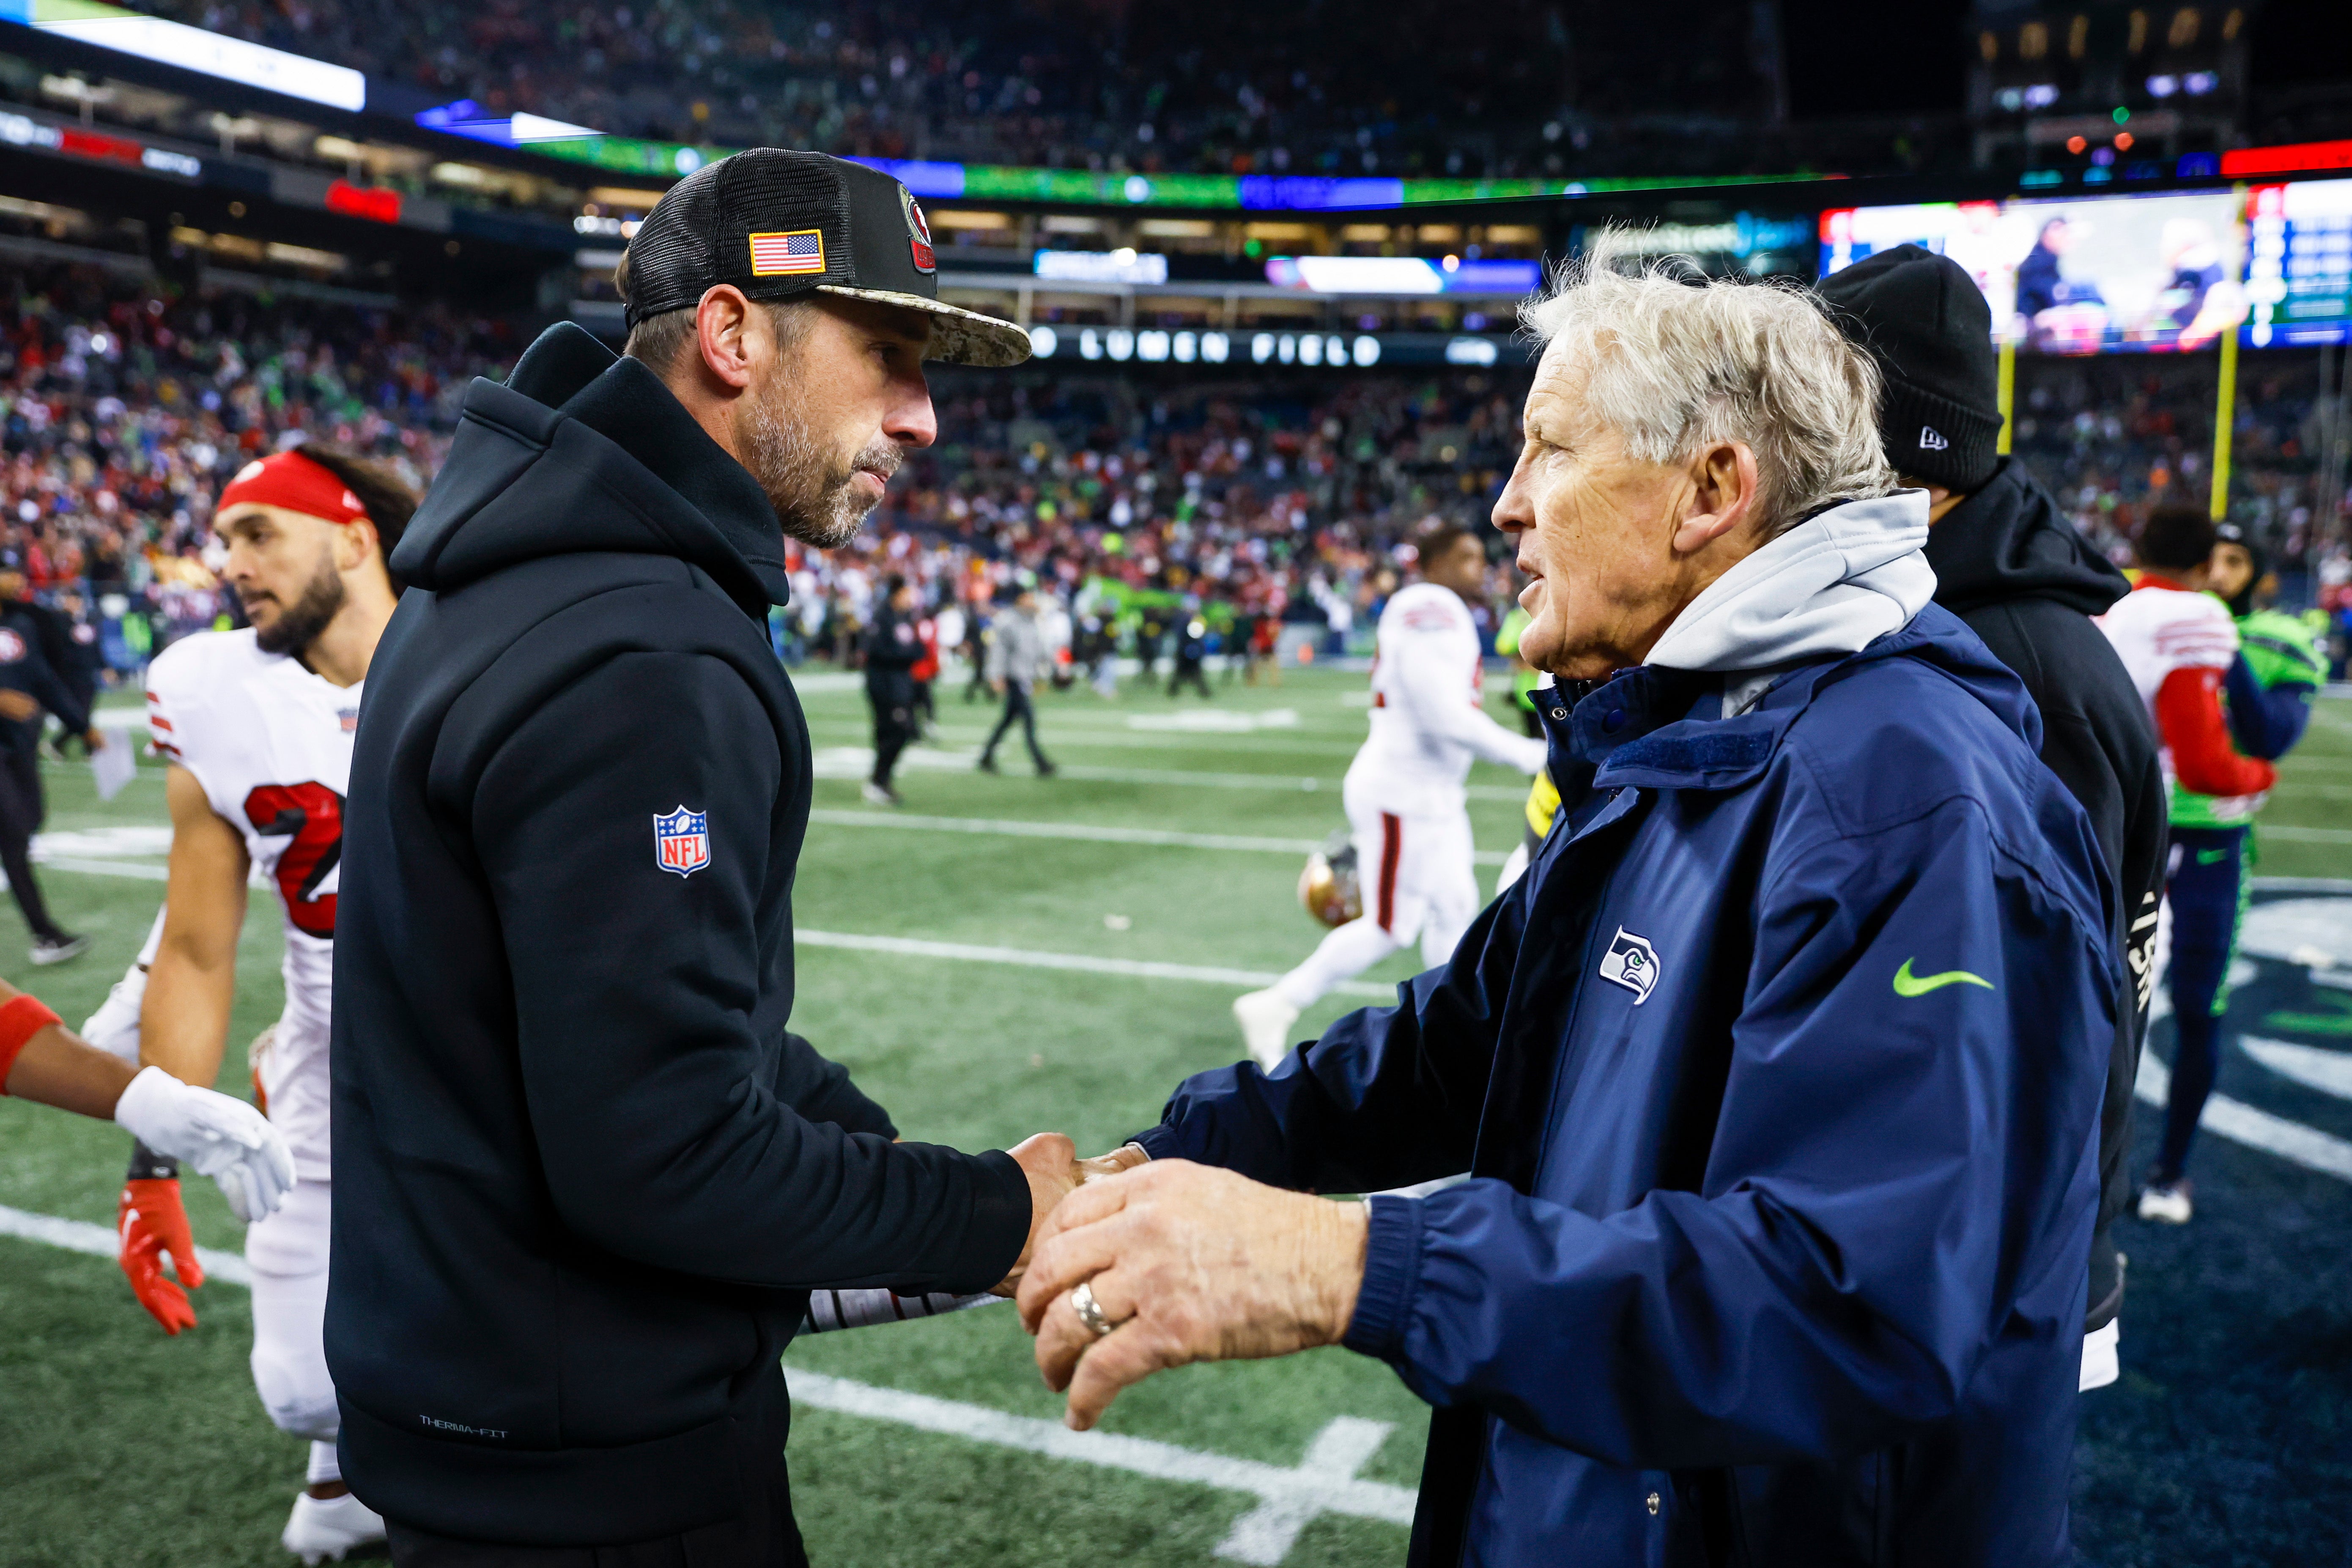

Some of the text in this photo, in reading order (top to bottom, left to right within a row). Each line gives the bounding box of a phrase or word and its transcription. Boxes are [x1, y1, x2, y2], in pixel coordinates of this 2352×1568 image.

[1080, 328, 1381, 367] LUMEN FIELD
[663, 836, 706, 867] NFL
[419, 1414, 508, 1438] THERMA-FIT
